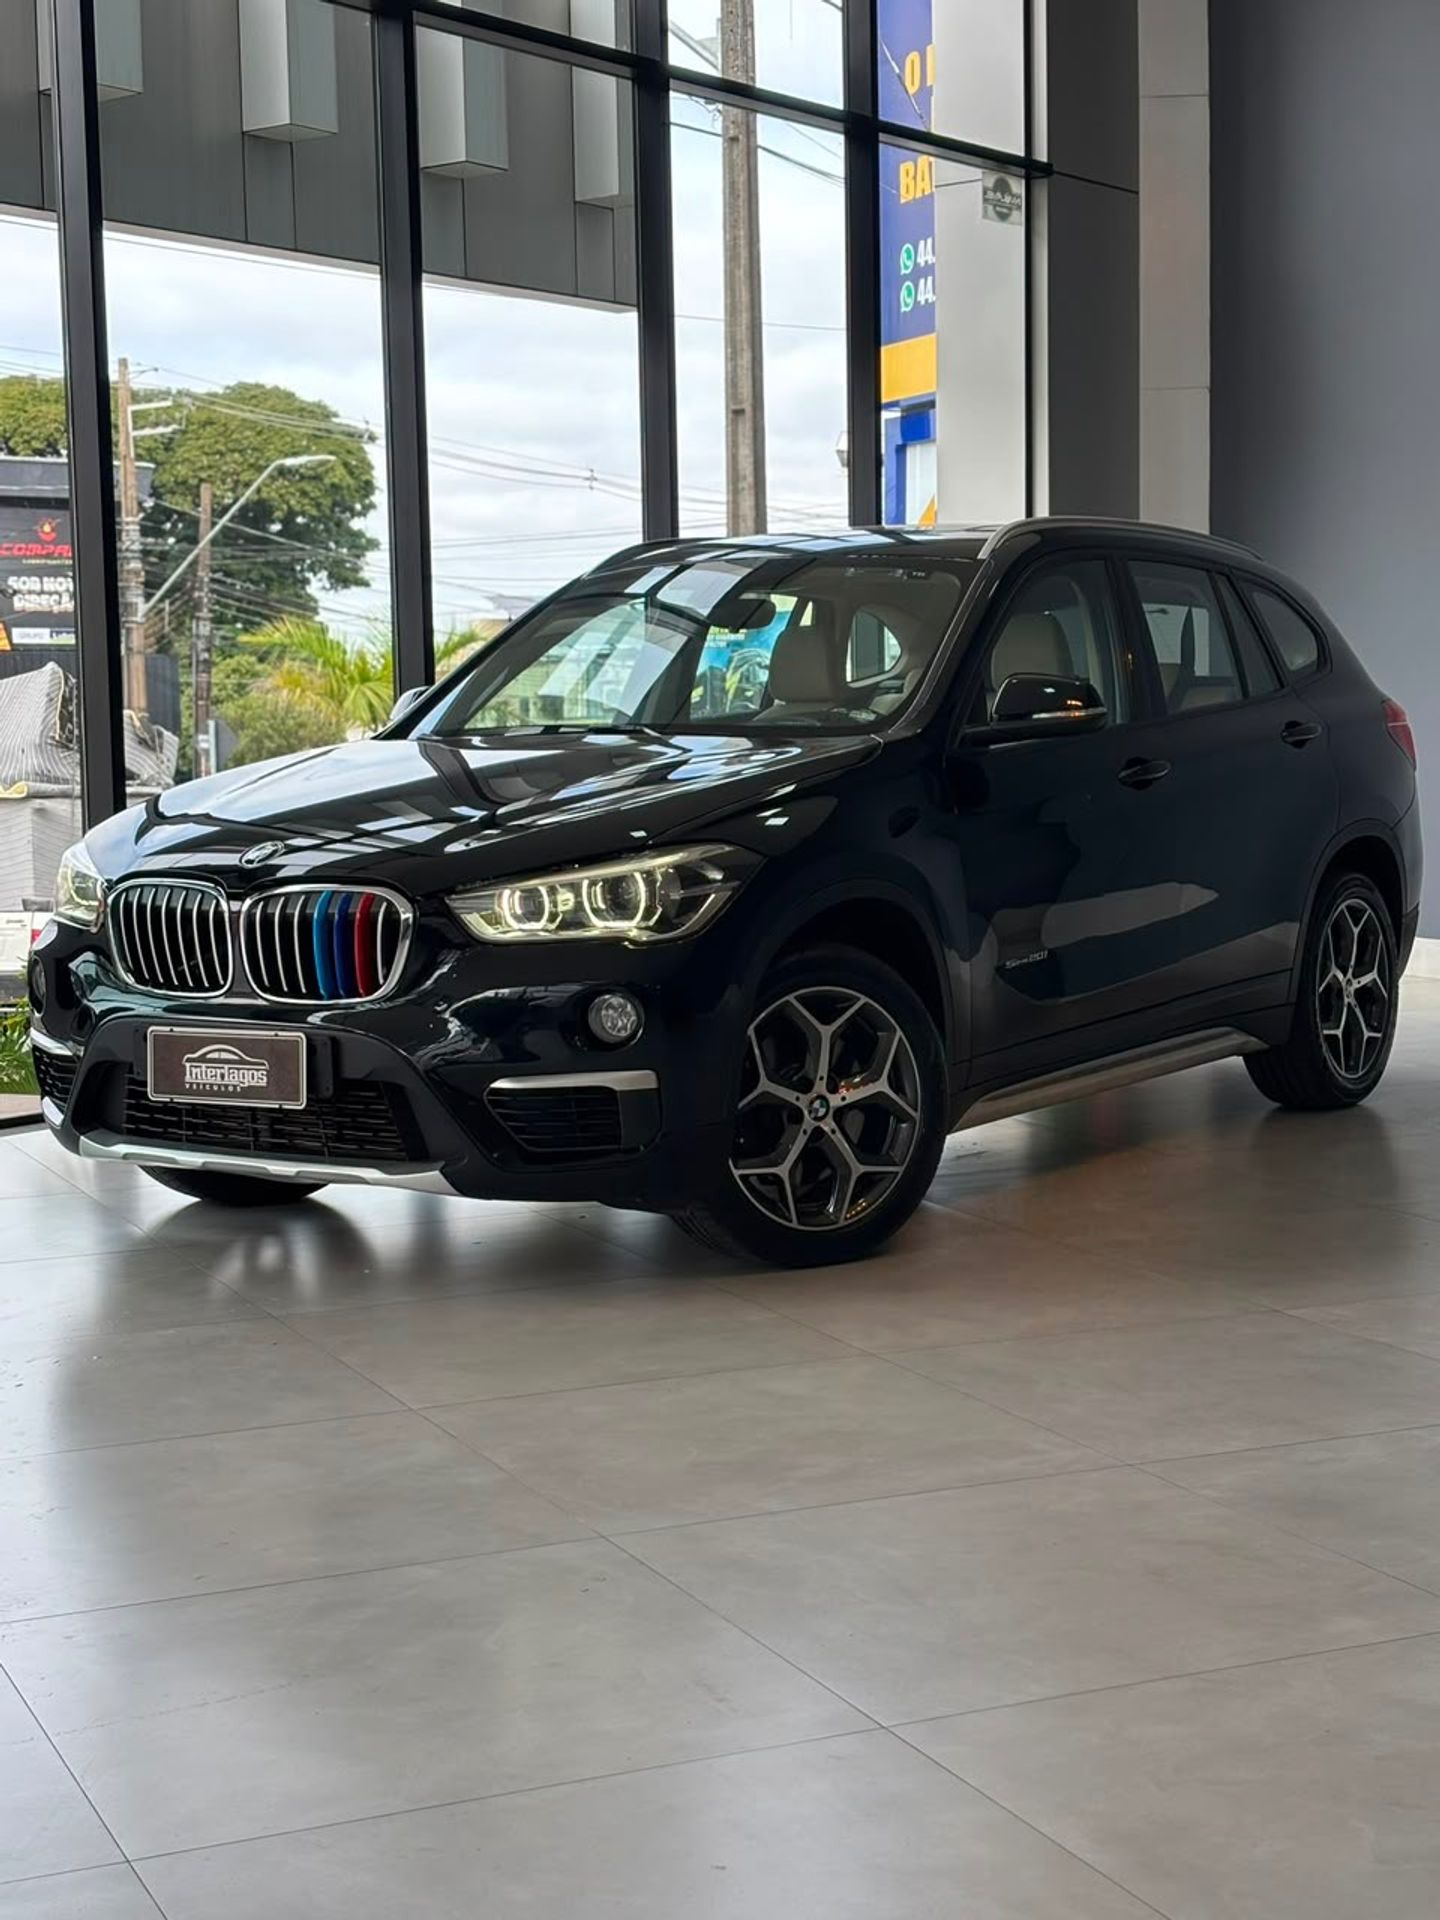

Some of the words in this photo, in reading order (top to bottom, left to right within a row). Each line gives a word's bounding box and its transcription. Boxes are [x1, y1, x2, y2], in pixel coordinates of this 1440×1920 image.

[0, 543, 72, 557] COMPA
[13, 592, 74, 613] DIREÇÃ
[184, 1062, 268, 1087] Interlagos
